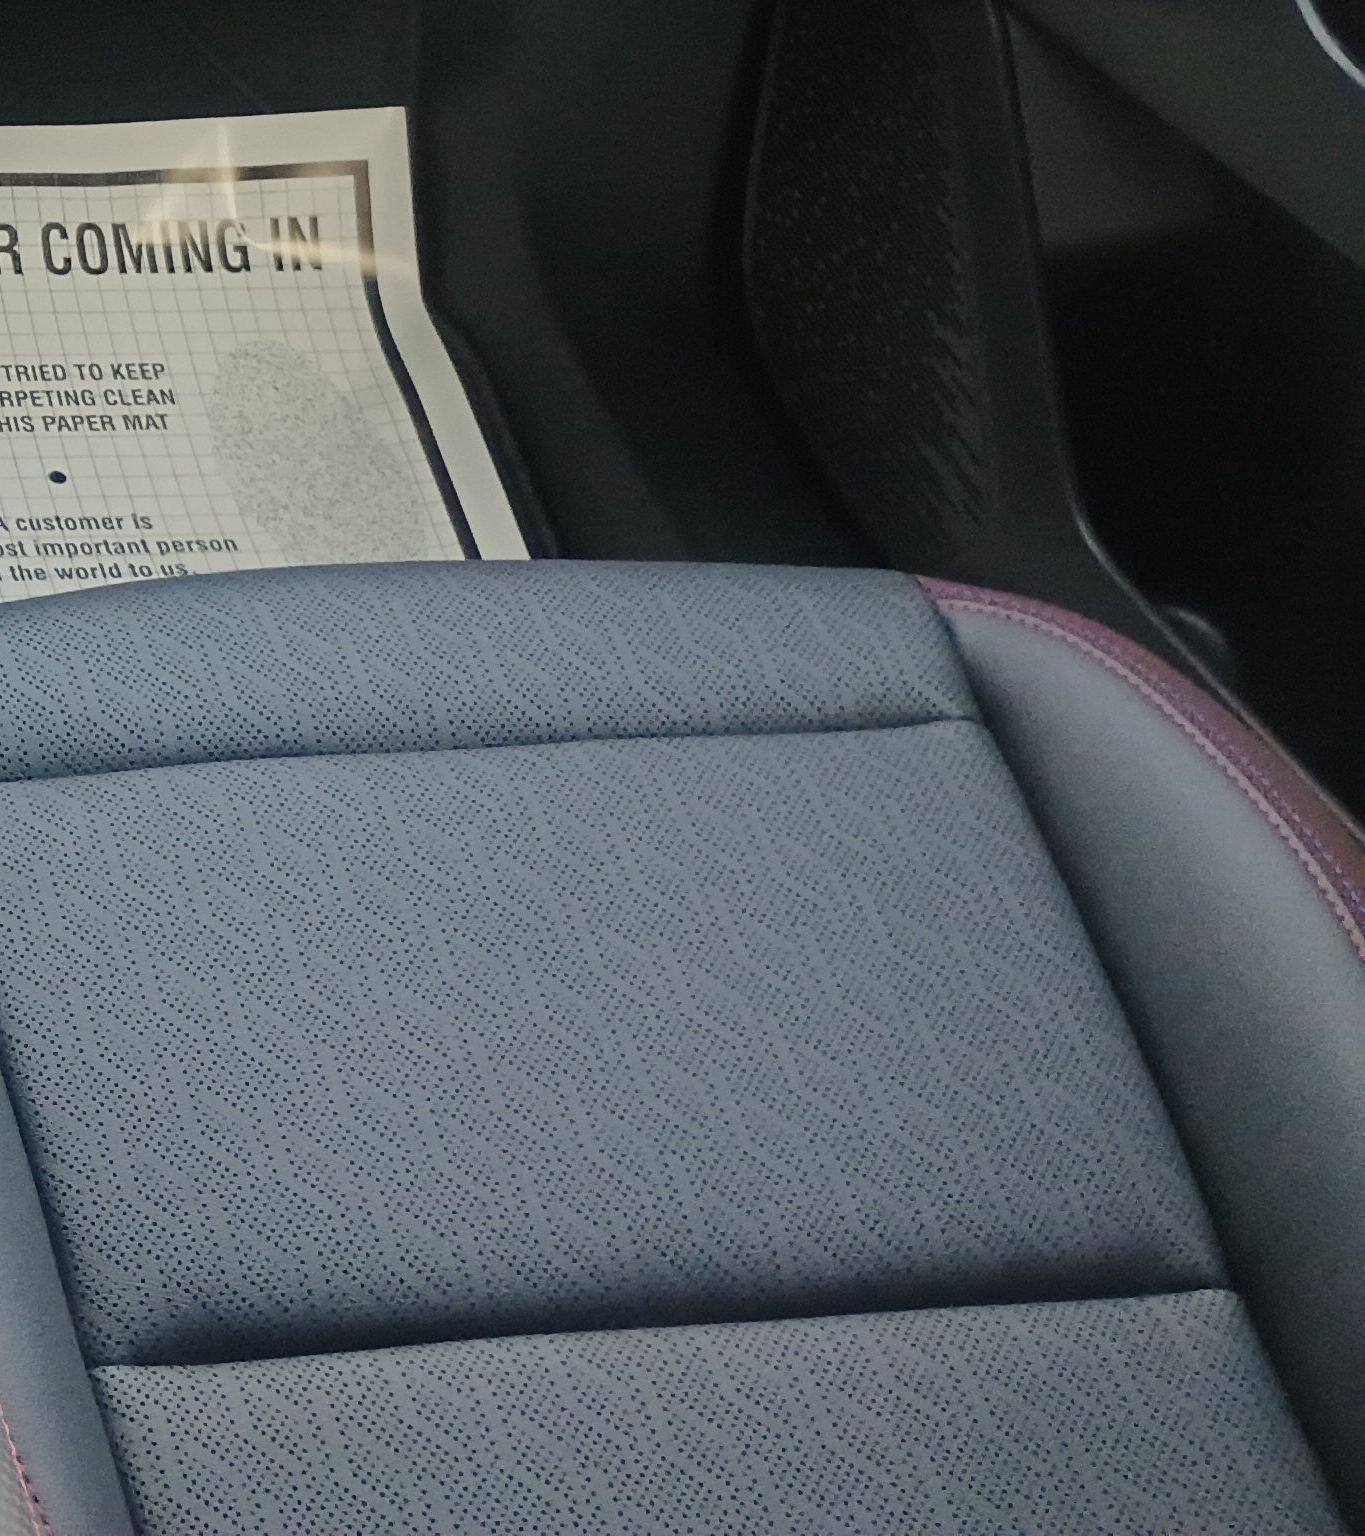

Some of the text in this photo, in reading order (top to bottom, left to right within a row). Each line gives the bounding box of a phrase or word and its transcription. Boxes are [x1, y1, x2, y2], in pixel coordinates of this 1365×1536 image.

[41, 219, 251, 275] COMING
[270, 216, 325, 272] IN
[0, 364, 67, 382] TRIED
[73, 364, 103, 381] TO
[110, 363, 166, 381] KEEP
[103, 388, 176, 406] CLEAN
[42, 414, 116, 432] PAPER
[123, 413, 170, 431] MAT
[15, 515, 125, 532] customer
[132, 513, 153, 530] is
[35, 538, 151, 559] important
[156, 537, 239, 555] person
[9, 565, 47, 581] the
[54, 563, 123, 580] world
[128, 562, 153, 578] to
